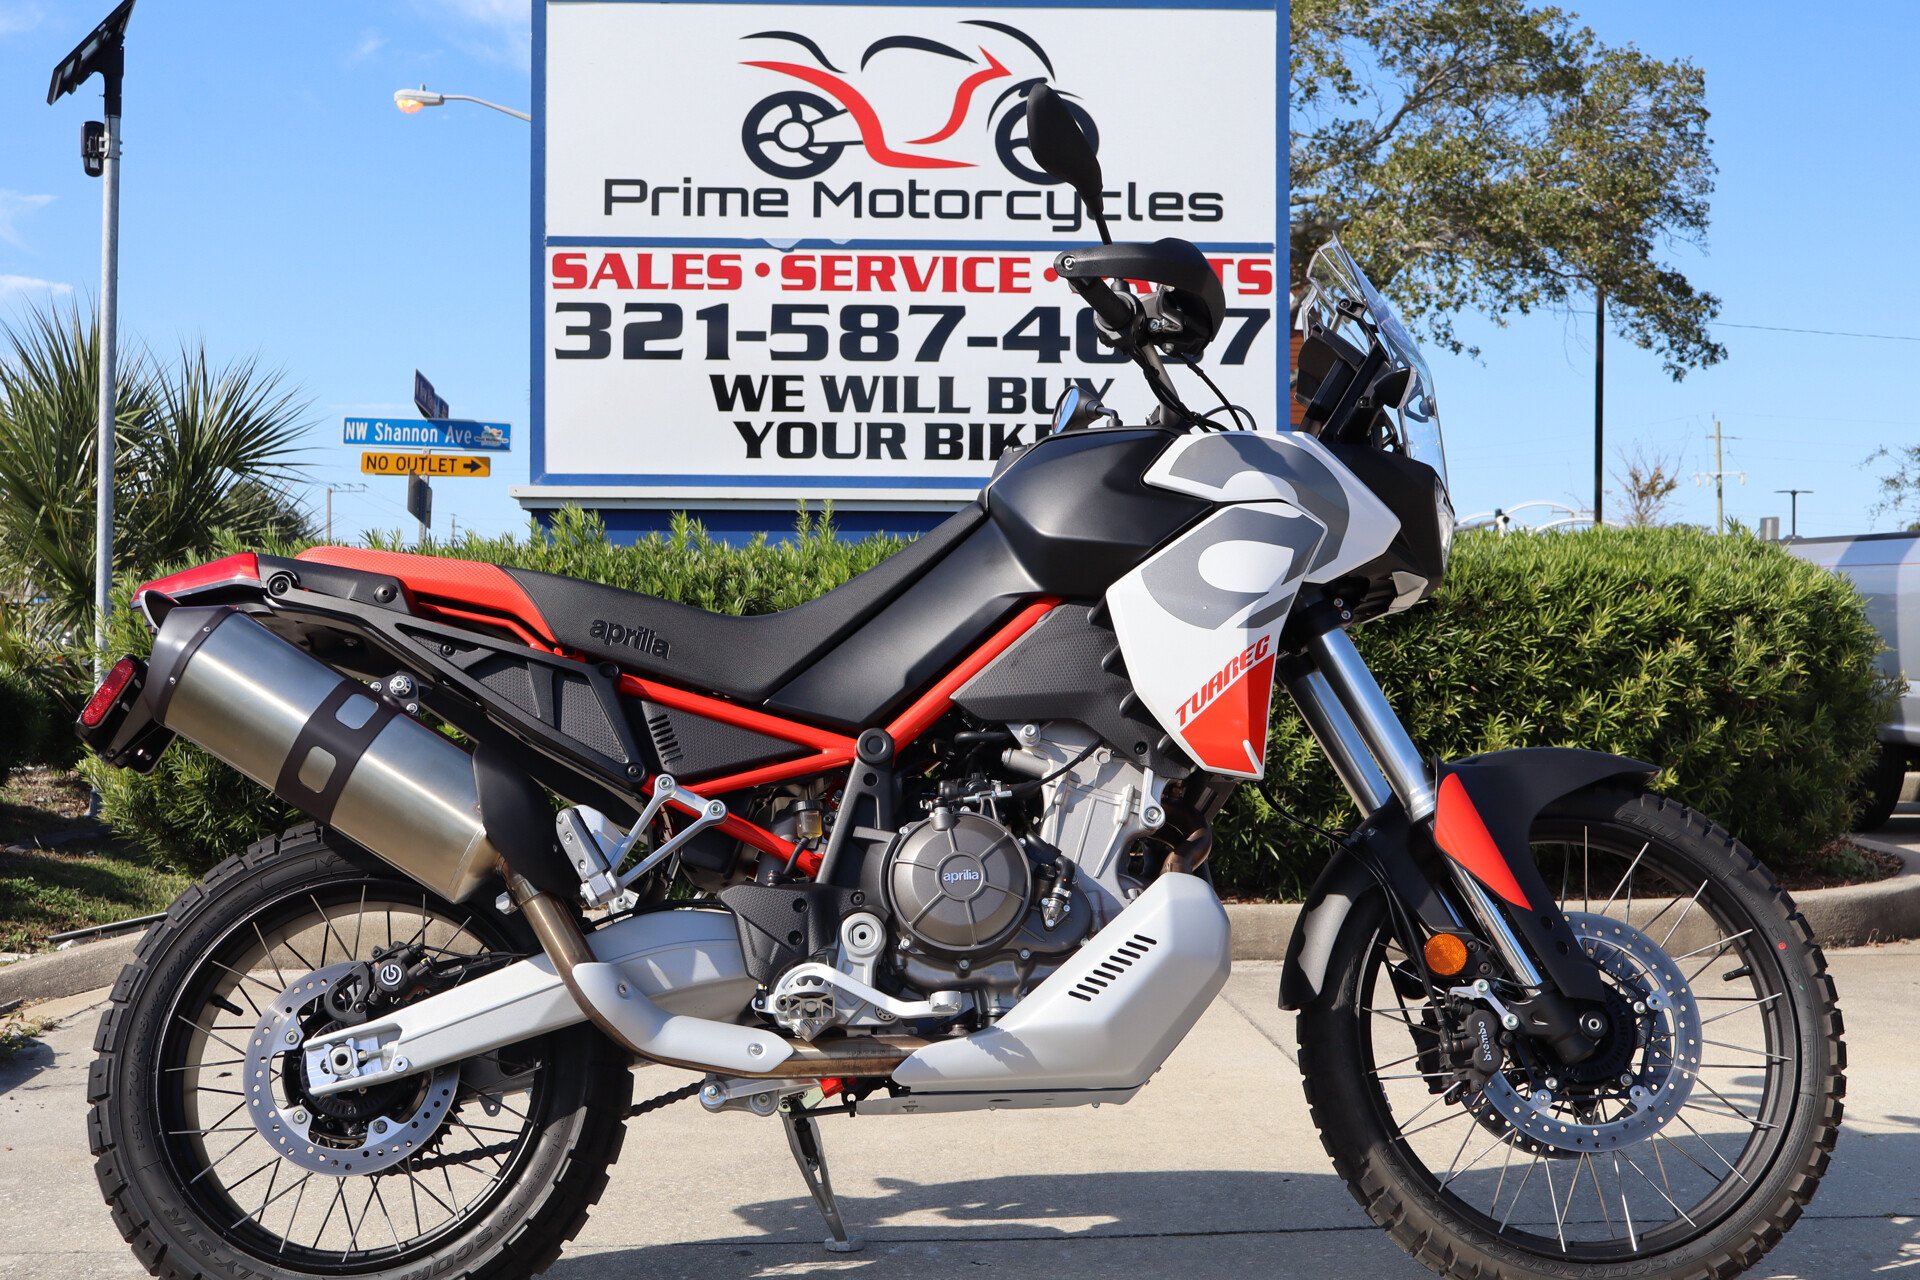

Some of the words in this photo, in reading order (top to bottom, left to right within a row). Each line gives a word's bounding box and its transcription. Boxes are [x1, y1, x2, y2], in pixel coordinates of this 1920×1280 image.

[605, 177, 789, 219] Prime
[814, 180, 1224, 232] Motorcycles
[552, 253, 742, 292] SALES
[781, 254, 1032, 294] SERVICE
[554, 302, 1271, 366] 321-587-47
[708, 374, 805, 413] WE
[820, 375, 971, 415] WILL
[345, 421, 368, 441] NW
[375, 421, 438, 443] Shannon
[445, 425, 472, 444] Ave
[733, 420, 907, 461] YOUR
[366, 455, 389, 471] NO
[396, 456, 457, 474] OUTLET
[590, 620, 671, 660] aprilia
[1175, 635, 1270, 727] TUAREG
[943, 869, 979, 884] aprilia
[1478, 1020, 1493, 1062] brembo
